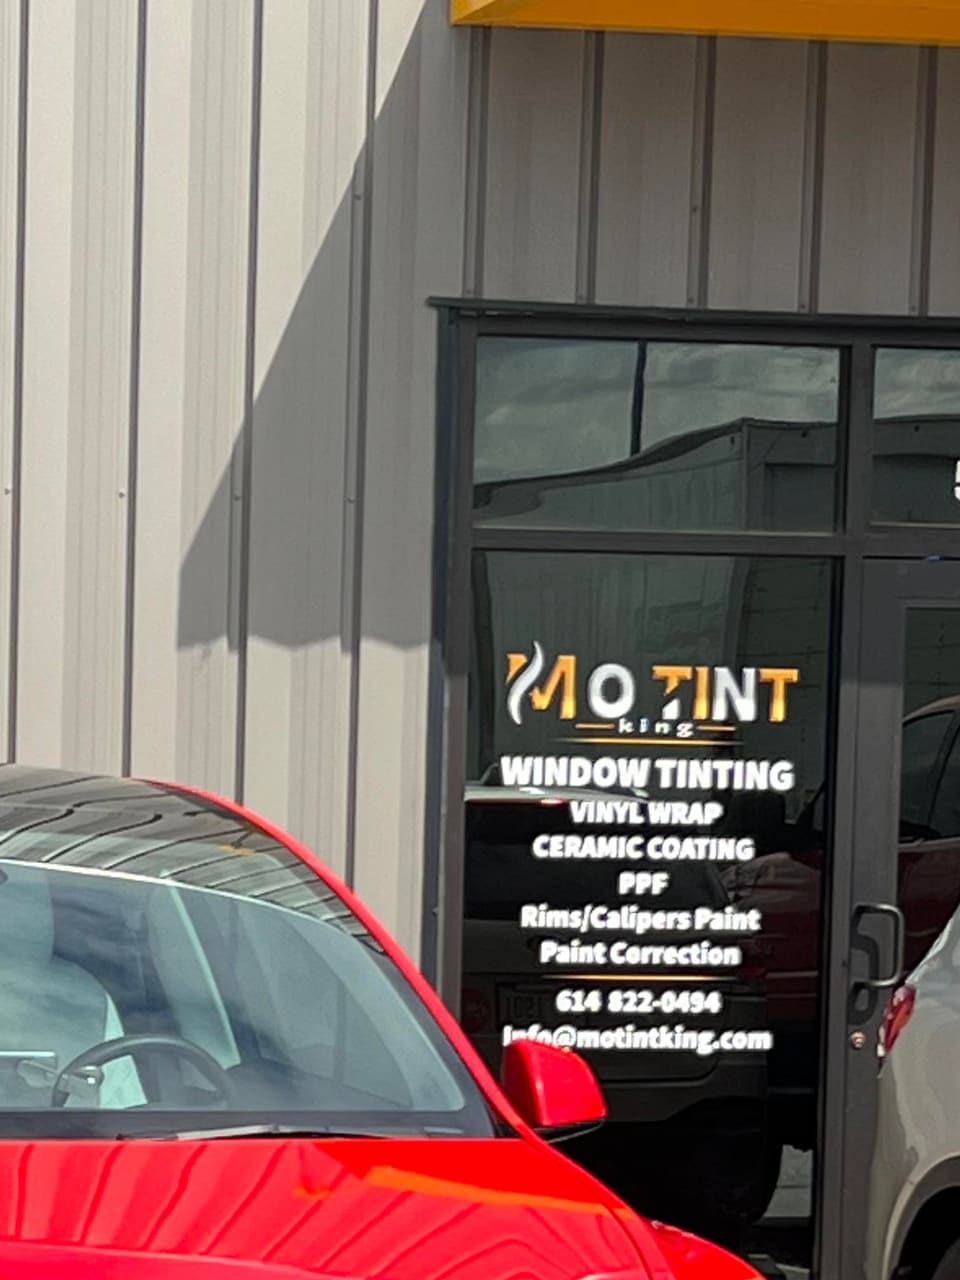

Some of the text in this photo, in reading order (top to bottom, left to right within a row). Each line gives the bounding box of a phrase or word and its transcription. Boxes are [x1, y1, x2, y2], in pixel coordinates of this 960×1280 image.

[652, 665, 800, 722] TINT
[618, 718, 694, 738] king
[500, 756, 795, 791] WINDOW TINTING
[569, 801, 723, 826] VINYL WRAP
[532, 834, 755, 862] CERAMIC COATING
[618, 871, 669, 895] PPF
[520, 904, 762, 934] Rims/Calipers Paint
[540, 939, 741, 966] Paint Correction
[555, 989, 603, 1013] 614
[607, 990, 722, 1014] 822-0494
